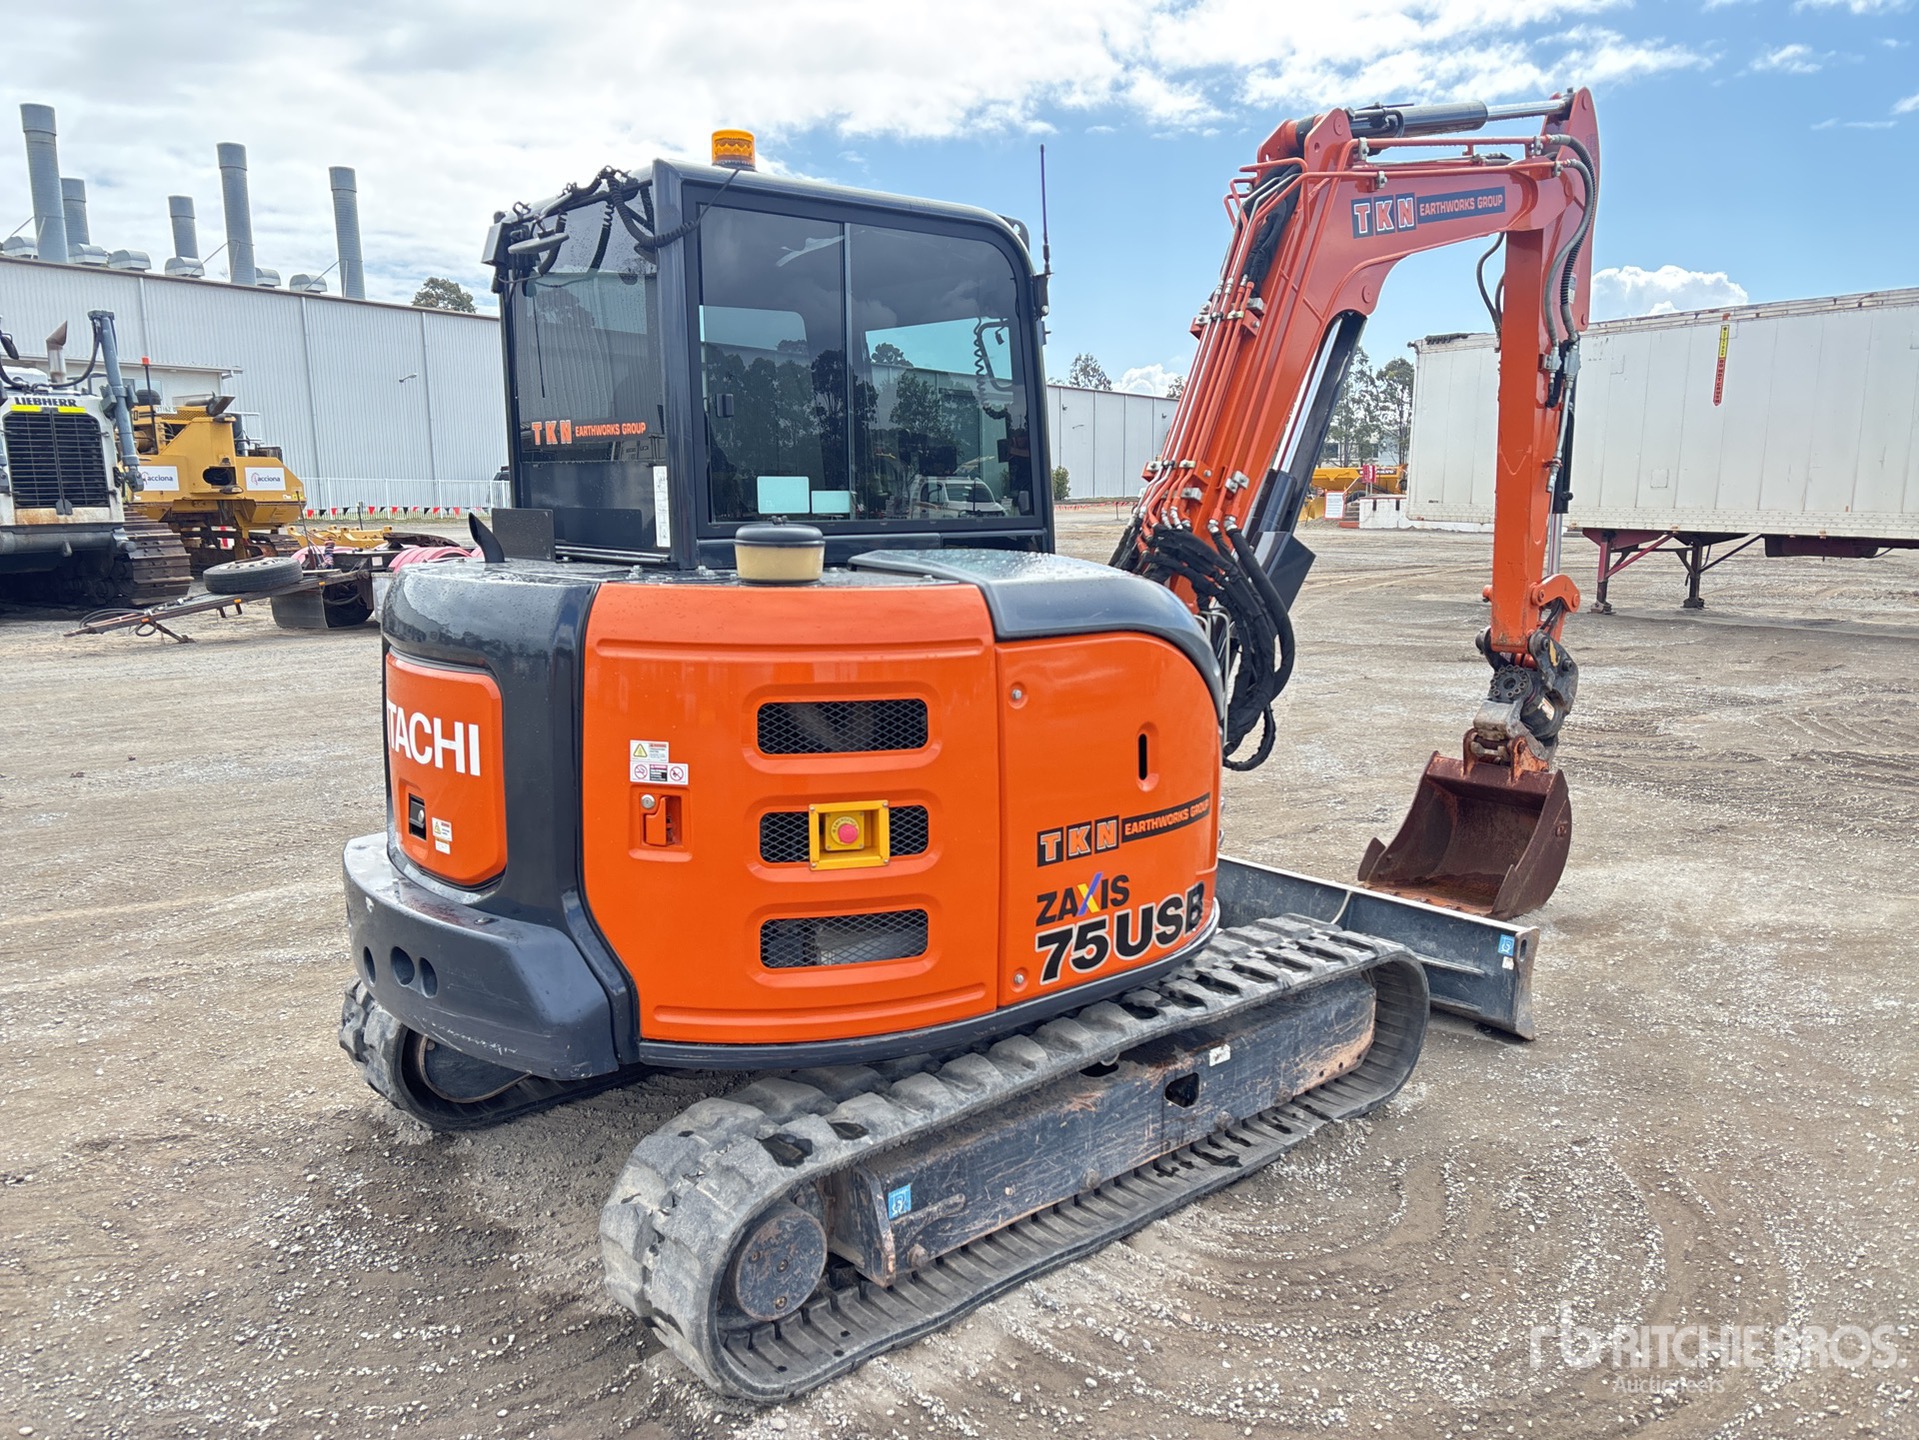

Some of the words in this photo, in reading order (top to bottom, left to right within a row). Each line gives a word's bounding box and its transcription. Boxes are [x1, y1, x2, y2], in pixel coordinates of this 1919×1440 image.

[1353, 197, 1415, 234] TKN
[1419, 197, 1475, 217] EARTHWORKS
[1477, 194, 1503, 209] GROUP
[14, 396, 77, 407] LIEBHERR
[531, 419, 573, 445] TKN
[575, 423, 621, 437] EARTHWORKS
[621, 421, 646, 435] GROUP
[1040, 819, 1118, 862] TKN
[1124, 808, 1189, 836] EARTHWORKS
[1190, 798, 1210, 818] GROUP
[1035, 871, 1130, 927] ZAXIS
[1035, 880, 1205, 986] 75USB
